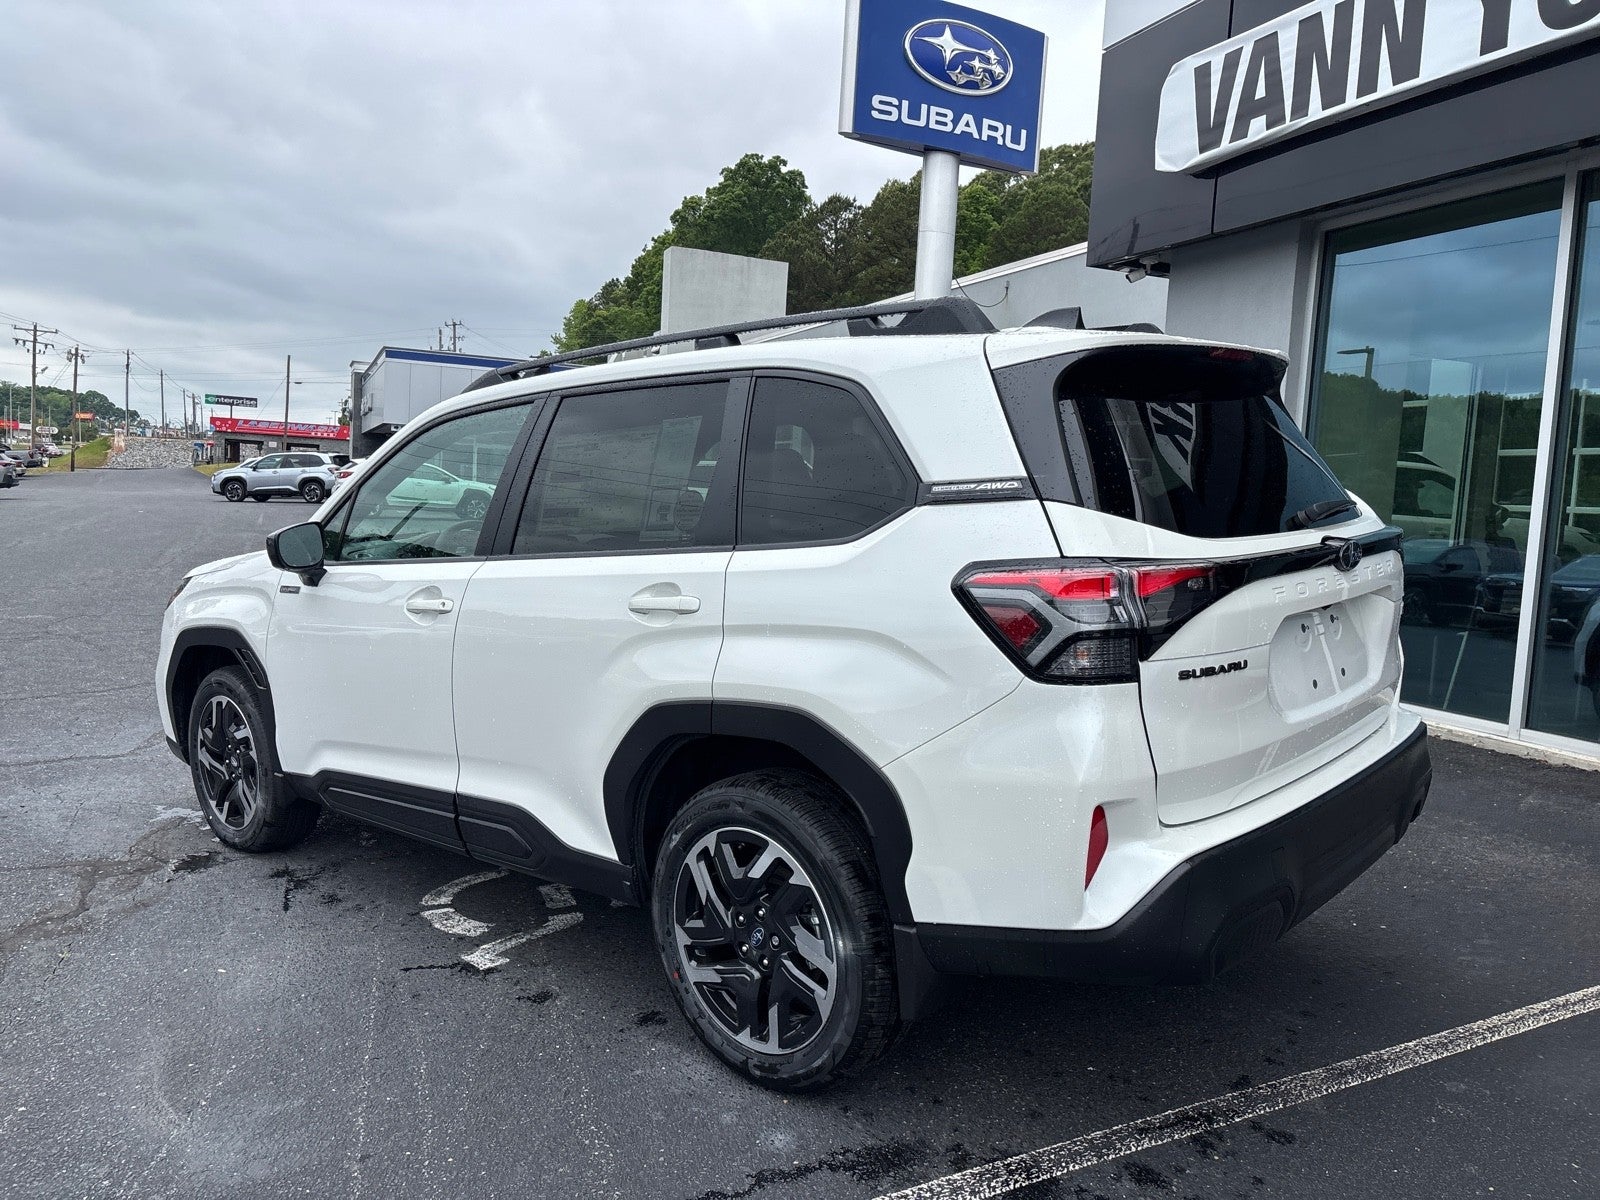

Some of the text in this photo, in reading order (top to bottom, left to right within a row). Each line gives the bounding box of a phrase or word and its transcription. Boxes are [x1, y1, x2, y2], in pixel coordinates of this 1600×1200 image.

[1194, 0, 1427, 155] VANN
[870, 94, 1027, 152] SUBARU
[207, 396, 257, 405] enterprise
[976, 481, 1019, 489] AWD
[1272, 560, 1395, 603] FORESTER
[1178, 659, 1248, 680] SUBARU
